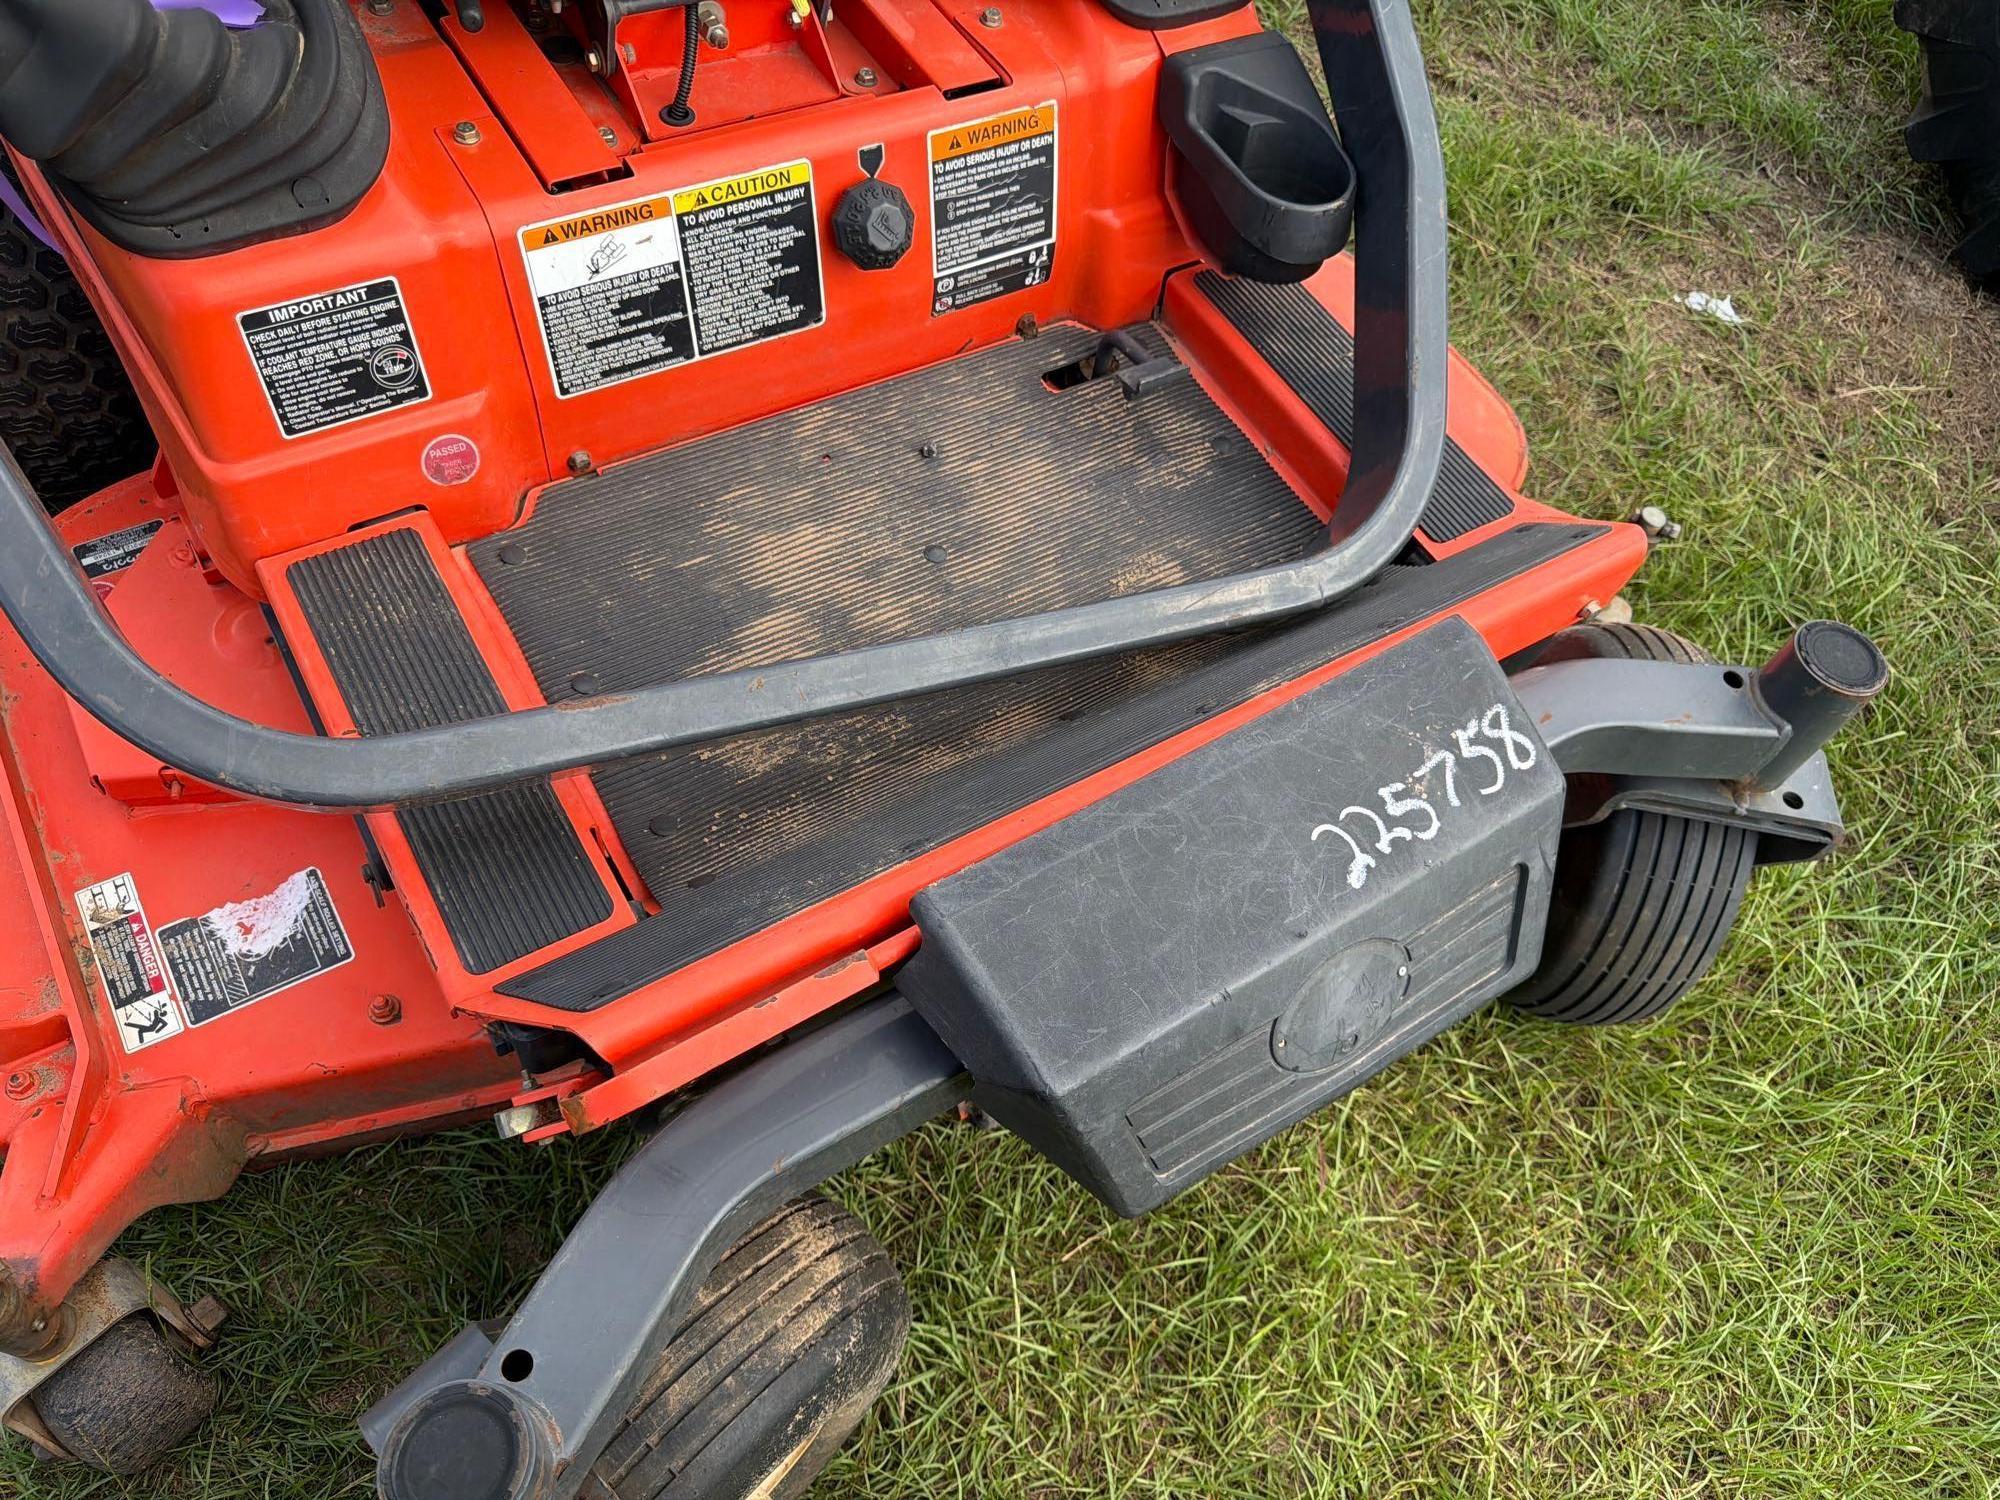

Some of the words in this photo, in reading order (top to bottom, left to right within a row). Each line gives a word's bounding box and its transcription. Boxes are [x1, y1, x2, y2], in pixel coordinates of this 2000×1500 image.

[968, 113, 1038, 144] WARNING
[934, 162, 943, 174] TO
[944, 157, 965, 171] AVOID
[966, 149, 994, 166] SERIOUS
[996, 142, 1019, 158] INJURY
[1020, 140, 1030, 151] OR
[1031, 134, 1052, 148] DEATH
[710, 169, 790, 202] CAUTION
[560, 202, 653, 239] WARNING
[682, 214, 696, 226] TO
[697, 206, 725, 223] AVOID
[726, 194, 773, 216] PERSONAL
[774, 186, 805, 204] INJURY
[684, 226, 703, 237] KNOW
[705, 218, 736, 232] LOCATION
[737, 214, 750, 224] AND
[752, 206, 782, 220] FUNCTION
[686, 235, 698, 244] ALL
[687, 239, 712, 251] BEFORE
[713, 231, 744, 244] STARTING
[688, 248, 706, 258] MAKE
[706, 241, 733, 254] CERTAIN
[735, 237, 747, 246] PTO
[689, 253, 714, 266] MOTION
[714, 245, 743, 259] CONTROL
[744, 239, 768, 251] LEVERS
[769, 236, 777, 244] TO
[778, 229, 805, 242] NEUTRAL
[690, 262, 707, 272] LOCK
[709, 258, 722, 268] AND
[723, 249, 755, 264] EVERYONE
[763, 245, 771, 253] AT
[778, 239, 794, 249] SAFE
[545, 294, 556, 305] TO
[556, 288, 580, 302] AVOID
[580, 280, 611, 296] SERIOUS
[612, 273, 638, 288] INJURY
[638, 270, 649, 281] OR
[650, 263, 674, 278] DEATH
[248, 330, 277, 344] CHECK
[276, 324, 300, 337] DAILY
[300, 316, 332, 331] BEFORE
[331, 307, 369, 323] STARTING
[368, 299, 399, 314] ENGINE.
[267, 288, 370, 322] IMPORTANT
[258, 338, 281, 348] Coolant
[316, 324, 338, 334] radiator
[349, 315, 373, 326] recovery
[258, 359, 266, 367] IF
[265, 350, 299, 365] COOLANT
[298, 338, 347, 357] TEMPERATURE
[346, 331, 371, 344] GAUGE
[370, 322, 406, 338] INDICATOR
[261, 344, 286, 355] Radiator
[286, 340, 305, 349] screen
[317, 331, 339, 341] radiator
[261, 360, 298, 376] REACHES
[297, 355, 314, 366] RED
[336, 346, 349, 356] OR
[348, 341, 371, 353] HORN
[383, 363, 405, 374] TEMP
[430, 442, 466, 458] PASSED
[1311, 704, 1536, 889] 225758
[135, 932, 159, 979] DANGER
